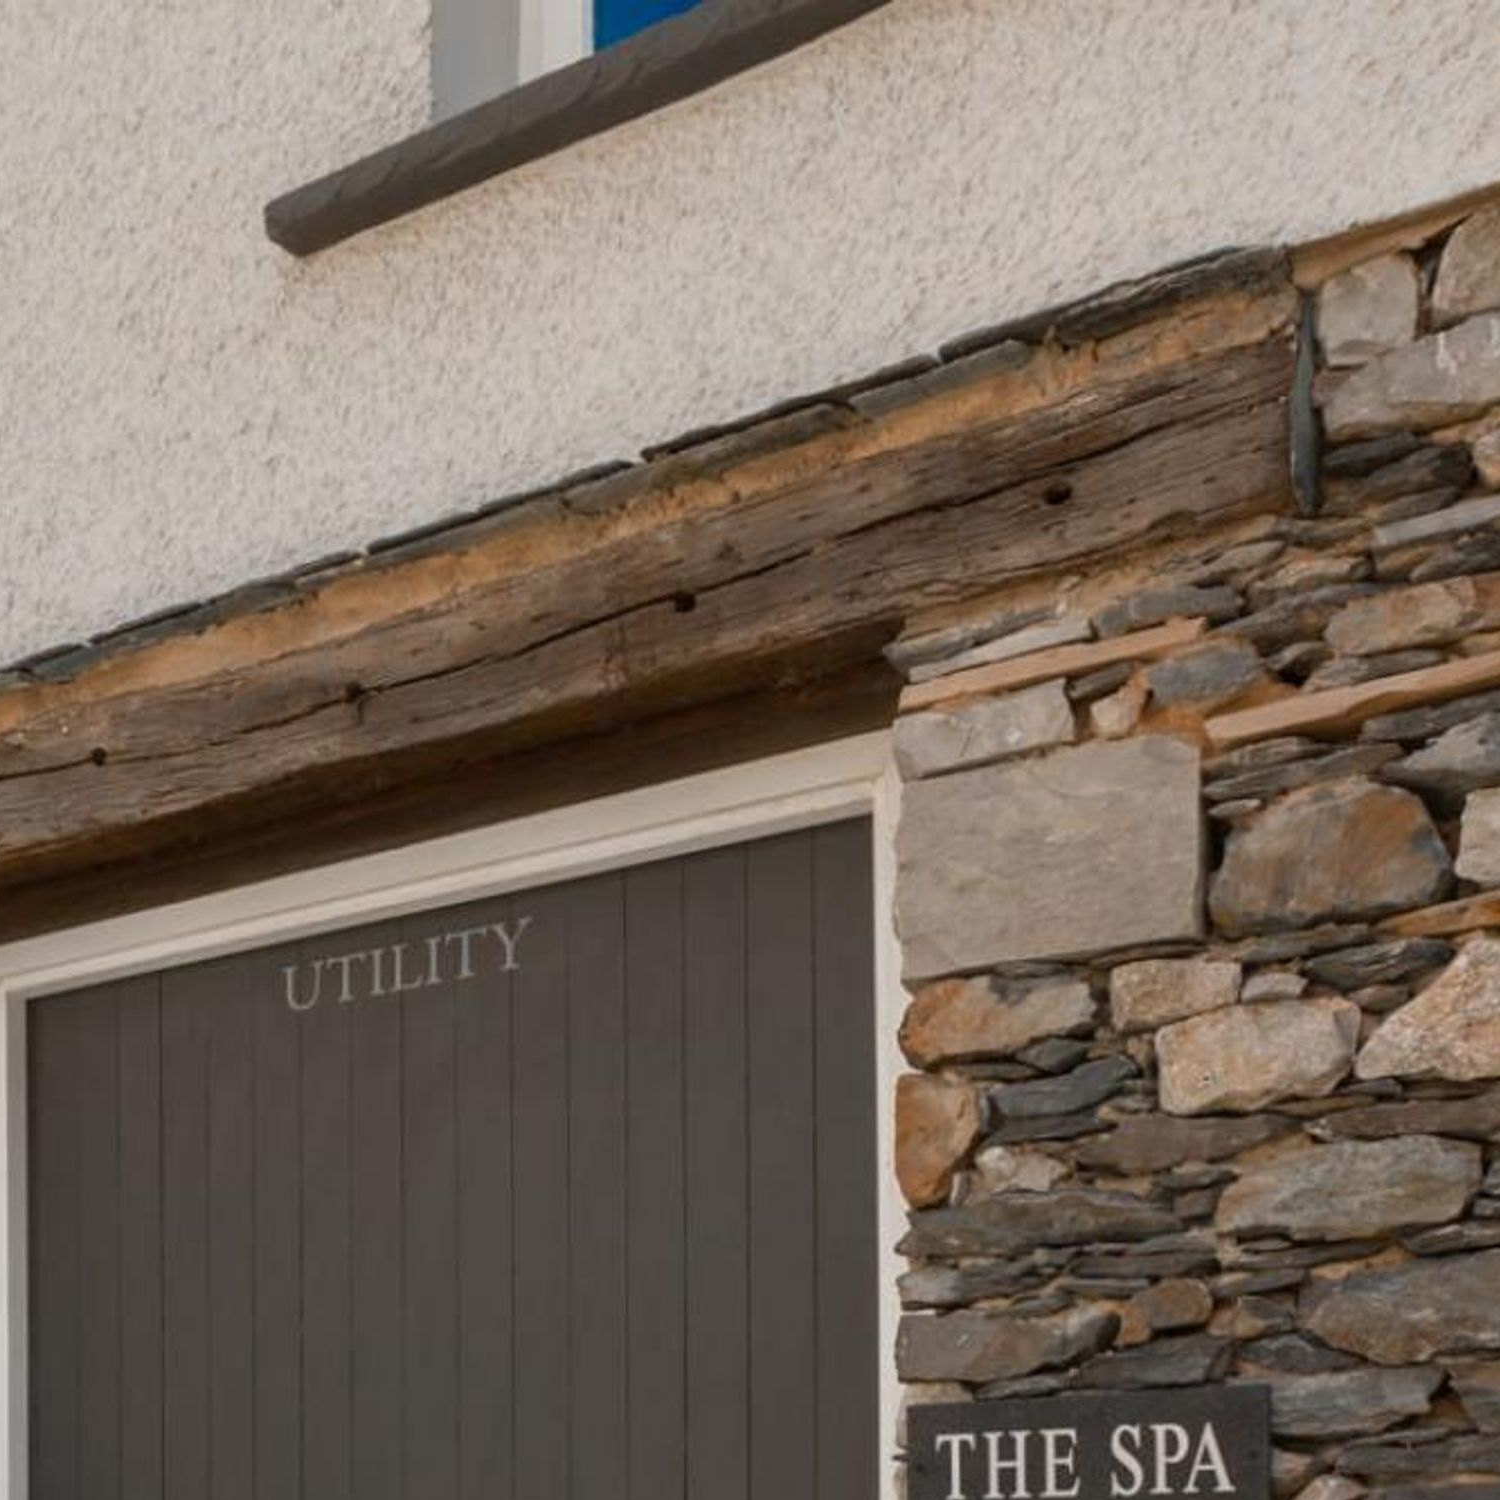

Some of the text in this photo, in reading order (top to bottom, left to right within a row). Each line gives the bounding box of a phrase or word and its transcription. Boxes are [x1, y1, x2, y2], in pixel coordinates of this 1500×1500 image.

[282, 917, 532, 1010] UTILITY
[935, 1422, 1236, 1500] THE SPA
